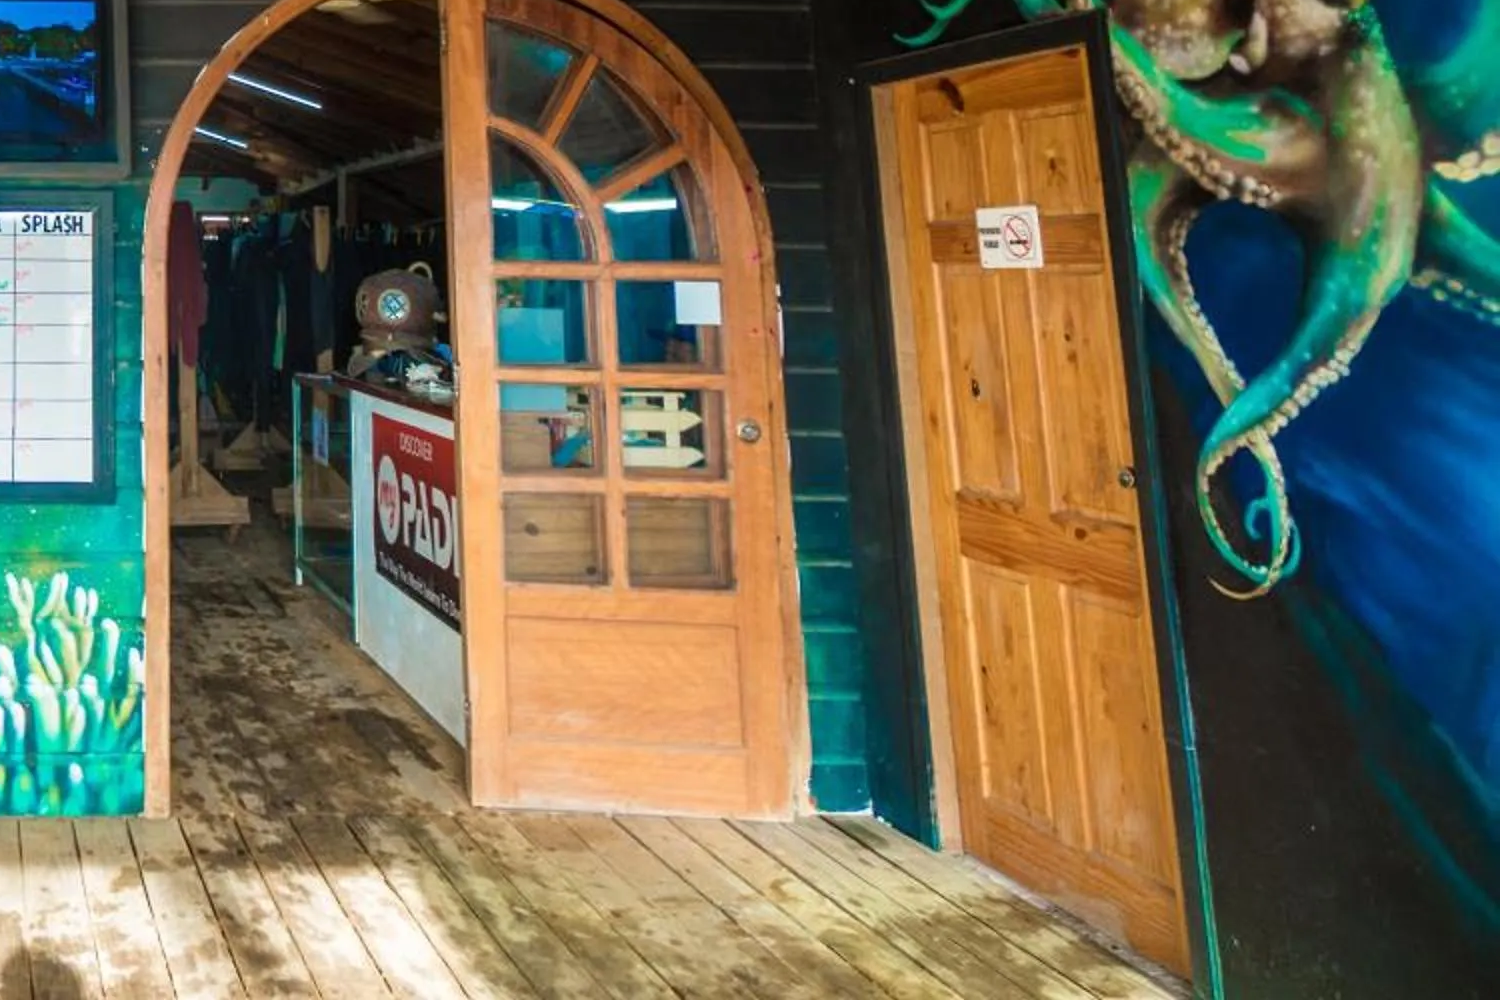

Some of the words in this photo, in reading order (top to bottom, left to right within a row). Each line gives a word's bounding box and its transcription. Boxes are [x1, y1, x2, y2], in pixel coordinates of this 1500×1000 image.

[21, 214, 84, 233] SPLASH
[399, 432, 433, 462] DISCOVER
[401, 471, 460, 579] PADI
